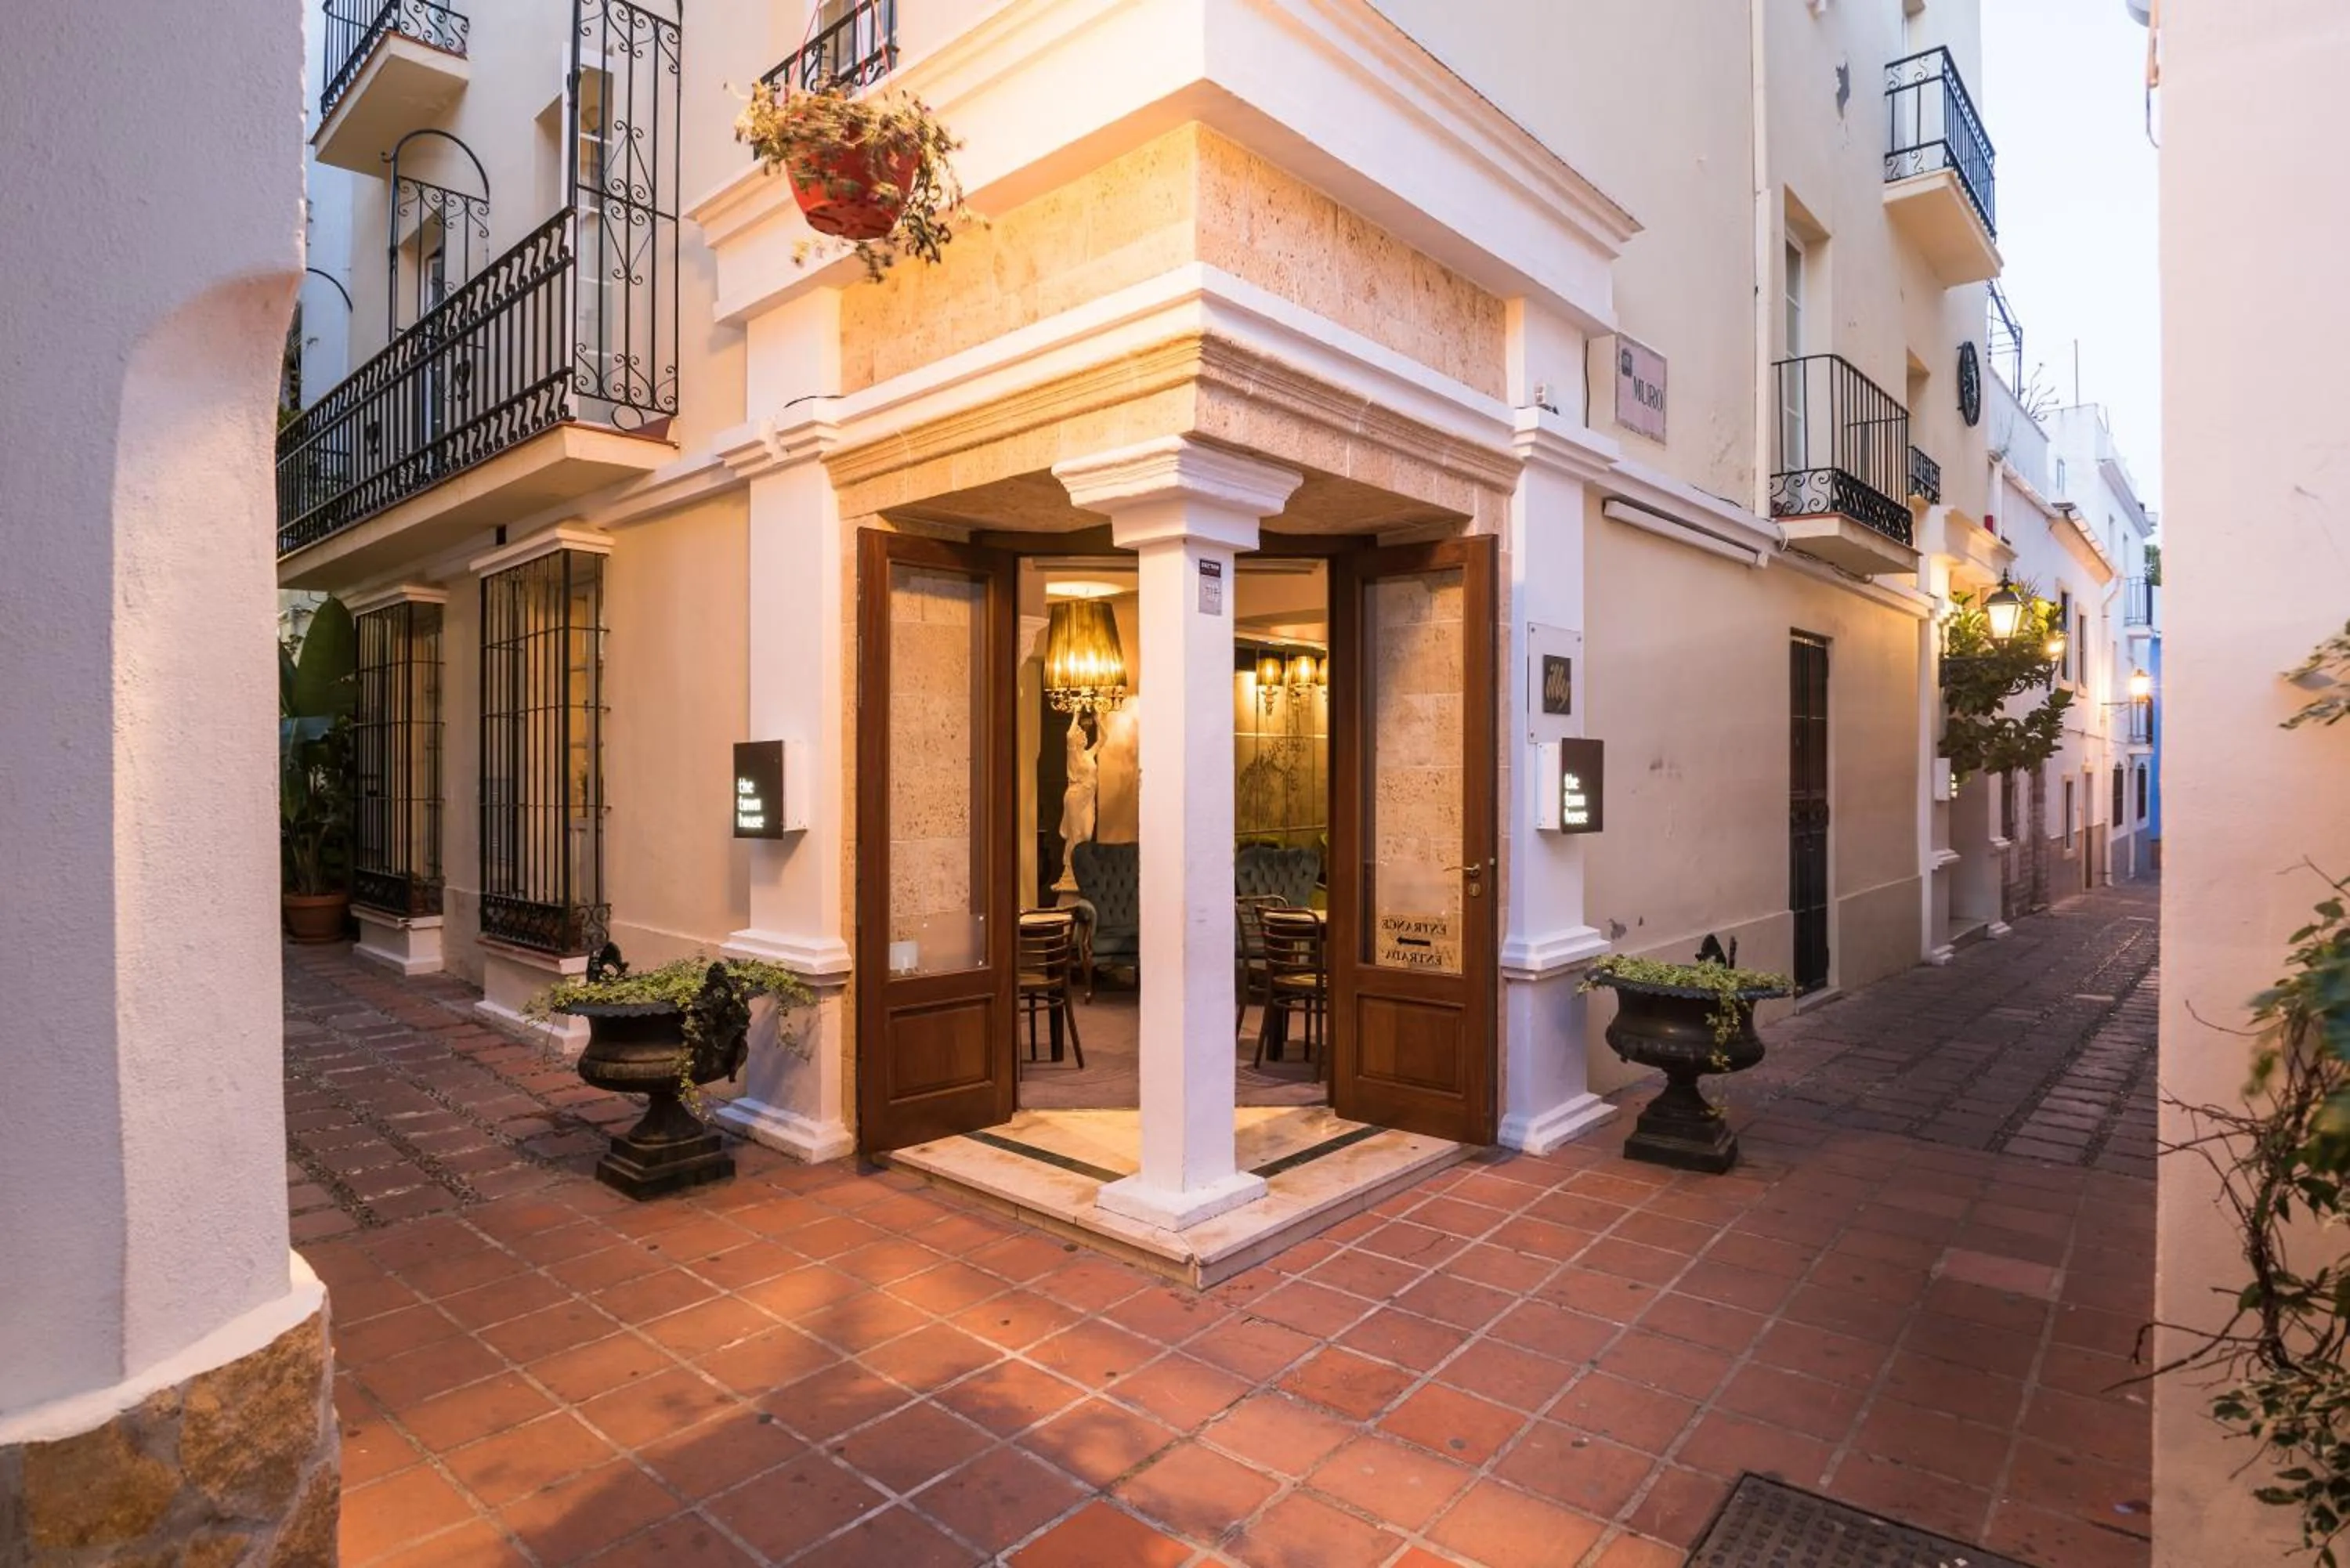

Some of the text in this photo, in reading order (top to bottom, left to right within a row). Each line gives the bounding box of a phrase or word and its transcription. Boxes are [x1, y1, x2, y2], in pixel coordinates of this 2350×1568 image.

[1632, 376, 1663, 411] MURO
[738, 778, 754, 793] the
[1564, 773, 1579, 789] the
[738, 796, 761, 811] town
[738, 813, 765, 828] house
[1564, 808, 1588, 825] house
